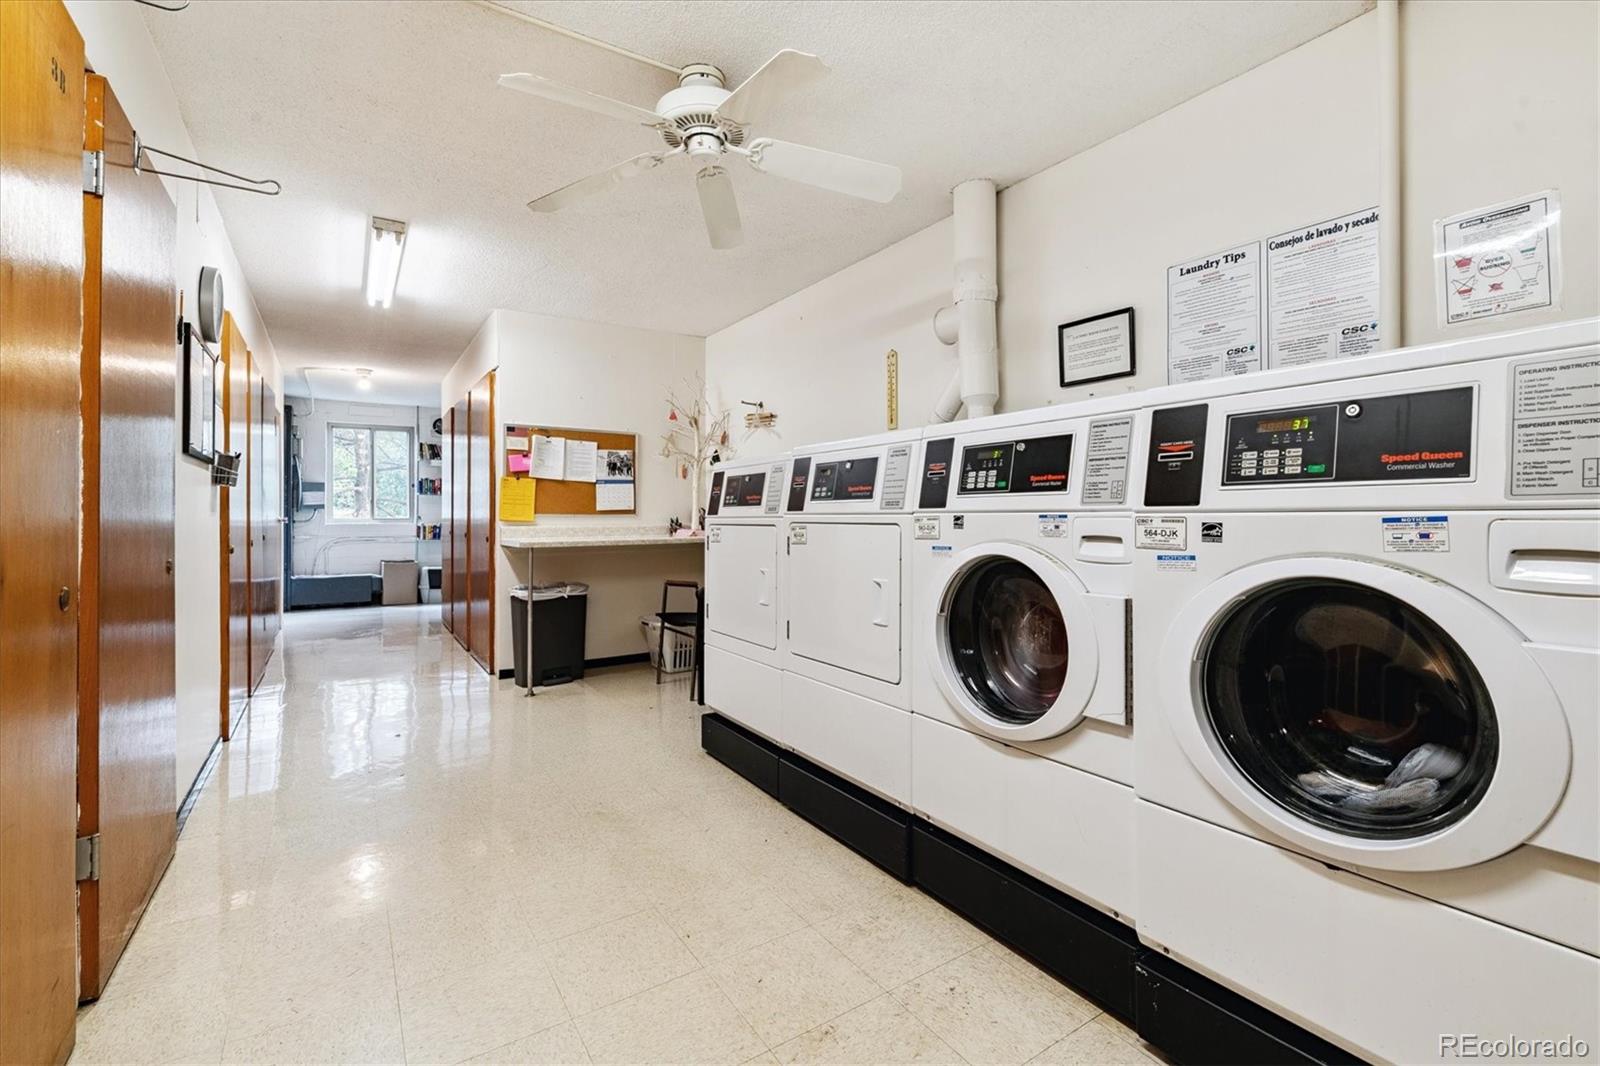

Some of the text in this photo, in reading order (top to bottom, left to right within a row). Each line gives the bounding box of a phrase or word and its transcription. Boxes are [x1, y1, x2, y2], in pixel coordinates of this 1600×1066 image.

[1269, 236, 1303, 251] Consejos
[1304, 231, 1314, 241] de
[1316, 224, 1343, 238] lavado
[1345, 222, 1350, 232] y
[1180, 252, 1246, 276] Laundry Tips
[1342, 324, 1368, 336] CSC
[1226, 346, 1248, 356] CSC
[1518, 366, 1558, 376] OPERATING
[1518, 421, 1556, 429] DISPENSER
[1381, 451, 1463, 463] Speed Queen
[1386, 462, 1427, 471] Commercial
[1144, 529, 1178, 538] 564-DJK
